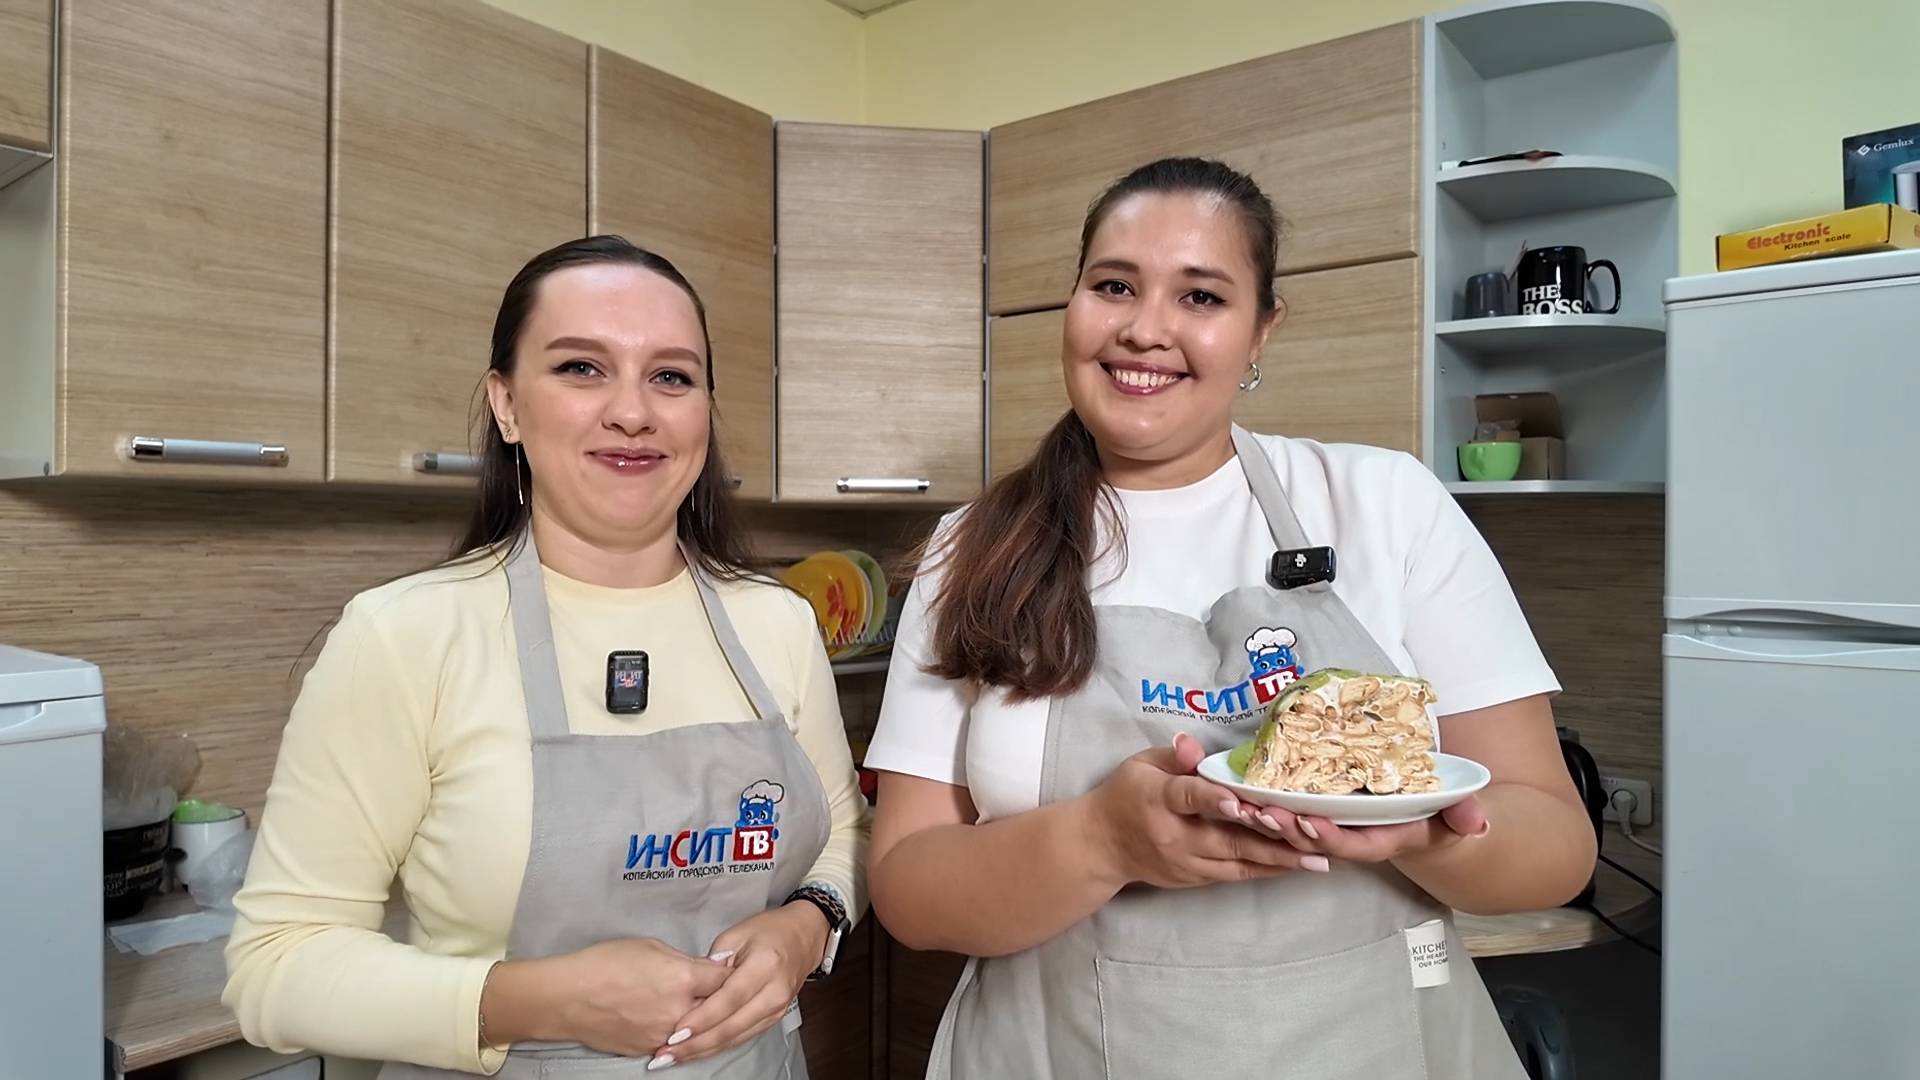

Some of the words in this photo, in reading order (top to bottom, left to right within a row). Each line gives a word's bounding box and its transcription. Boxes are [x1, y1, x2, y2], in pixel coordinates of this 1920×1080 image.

[1873, 138, 1914, 152] Gemlux
[1746, 223, 1831, 250] Electronic
[1784, 240, 1820, 251] Kitchen
[1825, 233, 1851, 243] scale
[1523, 285, 1560, 302] THE
[1522, 299, 1583, 316] BOSS
[1141, 678, 1251, 714] ИНСИТ
[625, 827, 733, 869] ИНСИТ
[739, 830, 770, 856] ТВ
[623, 868, 675, 881] КОПЕЙСКИЙ
[678, 864, 725, 879] ГОРОДСКОЙ
[728, 862, 775, 874] ТЕЛЕКАНАЛ
[1426, 951, 1445, 960] HEART
